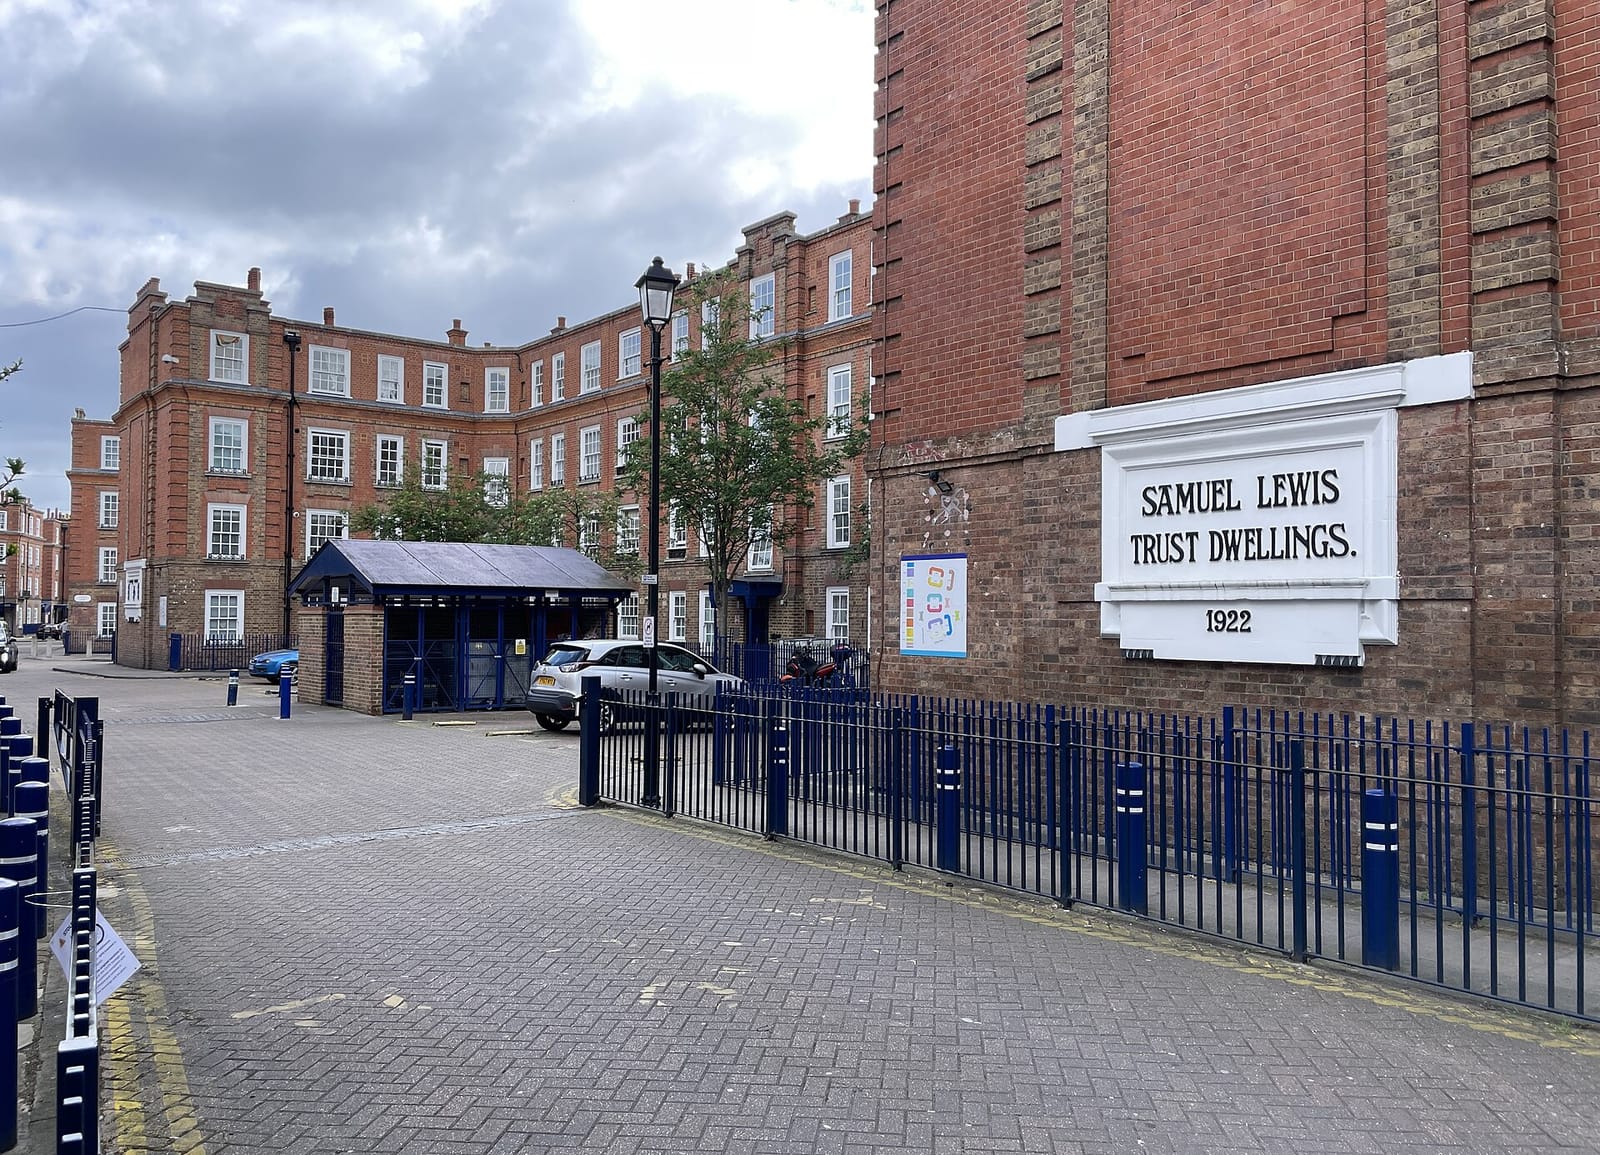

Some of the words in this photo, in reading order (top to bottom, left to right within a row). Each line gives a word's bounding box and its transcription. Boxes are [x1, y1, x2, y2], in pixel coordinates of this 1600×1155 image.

[1141, 478, 1241, 517] SAMUEL
[1256, 469, 1340, 509] LEWIS
[1130, 531, 1199, 565] TRUST
[1208, 523, 1357, 562] DWELLINGS.
[1205, 609, 1252, 633] 1922
